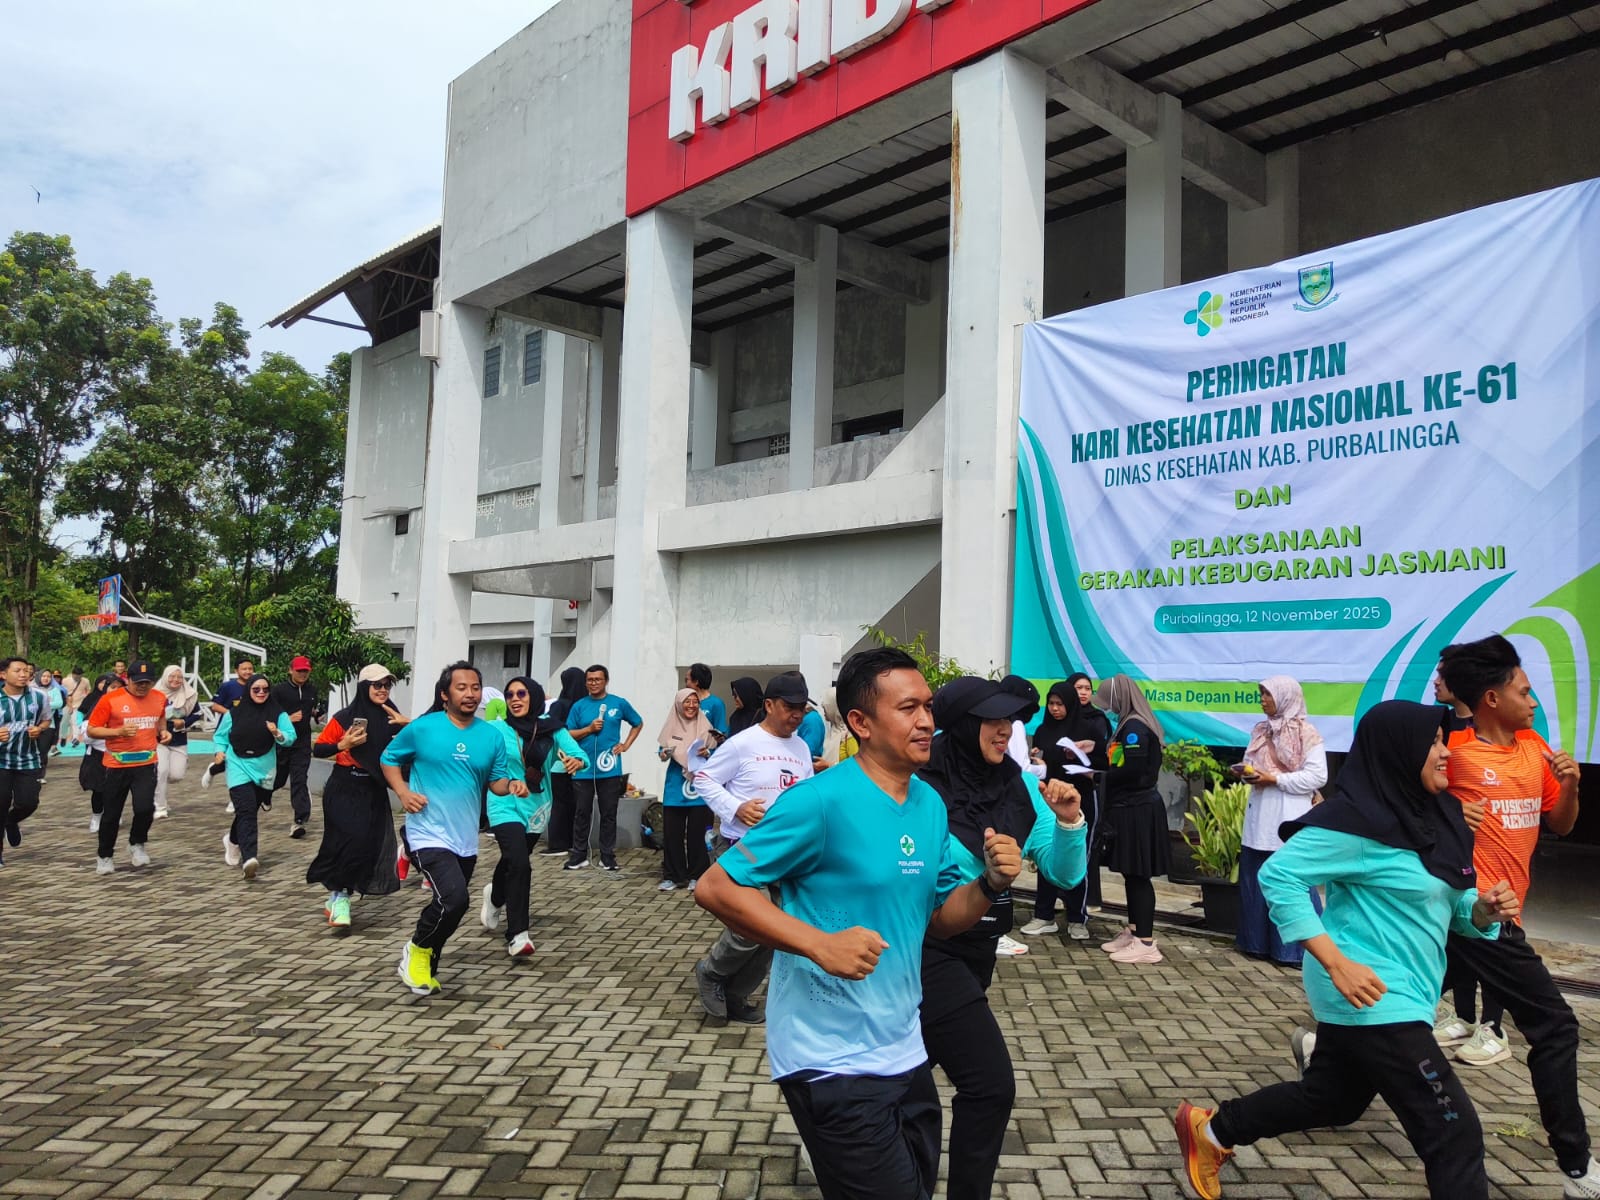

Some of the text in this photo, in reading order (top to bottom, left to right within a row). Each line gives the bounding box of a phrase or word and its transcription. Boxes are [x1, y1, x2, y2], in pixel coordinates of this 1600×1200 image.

[668, 0, 952, 142] KRID
[1230, 279, 1282, 298] KEMENTERIAN
[1230, 291, 1272, 307] KESEHATAN
[1229, 310, 1269, 324] INDONESIA
[1230, 301, 1266, 315] REPUBLIK
[1186, 341, 1347, 402] PERINGATAN
[1071, 361, 1518, 464] HARI KESEHATAN NASIONAL KE-61
[1104, 420, 1460, 488] DINAS KESEHATAN KAB. PURBALINGGA
[1234, 484, 1291, 510] DAN
[1170, 524, 1362, 560] PELAKSANAAN
[1078, 545, 1507, 591] GERAKAN KEBUGARAN JASMANI
[1162, 606, 1381, 627] Purbalingga, 12 November 2025
[1145, 689, 1262, 706] Masa Depan Heb
